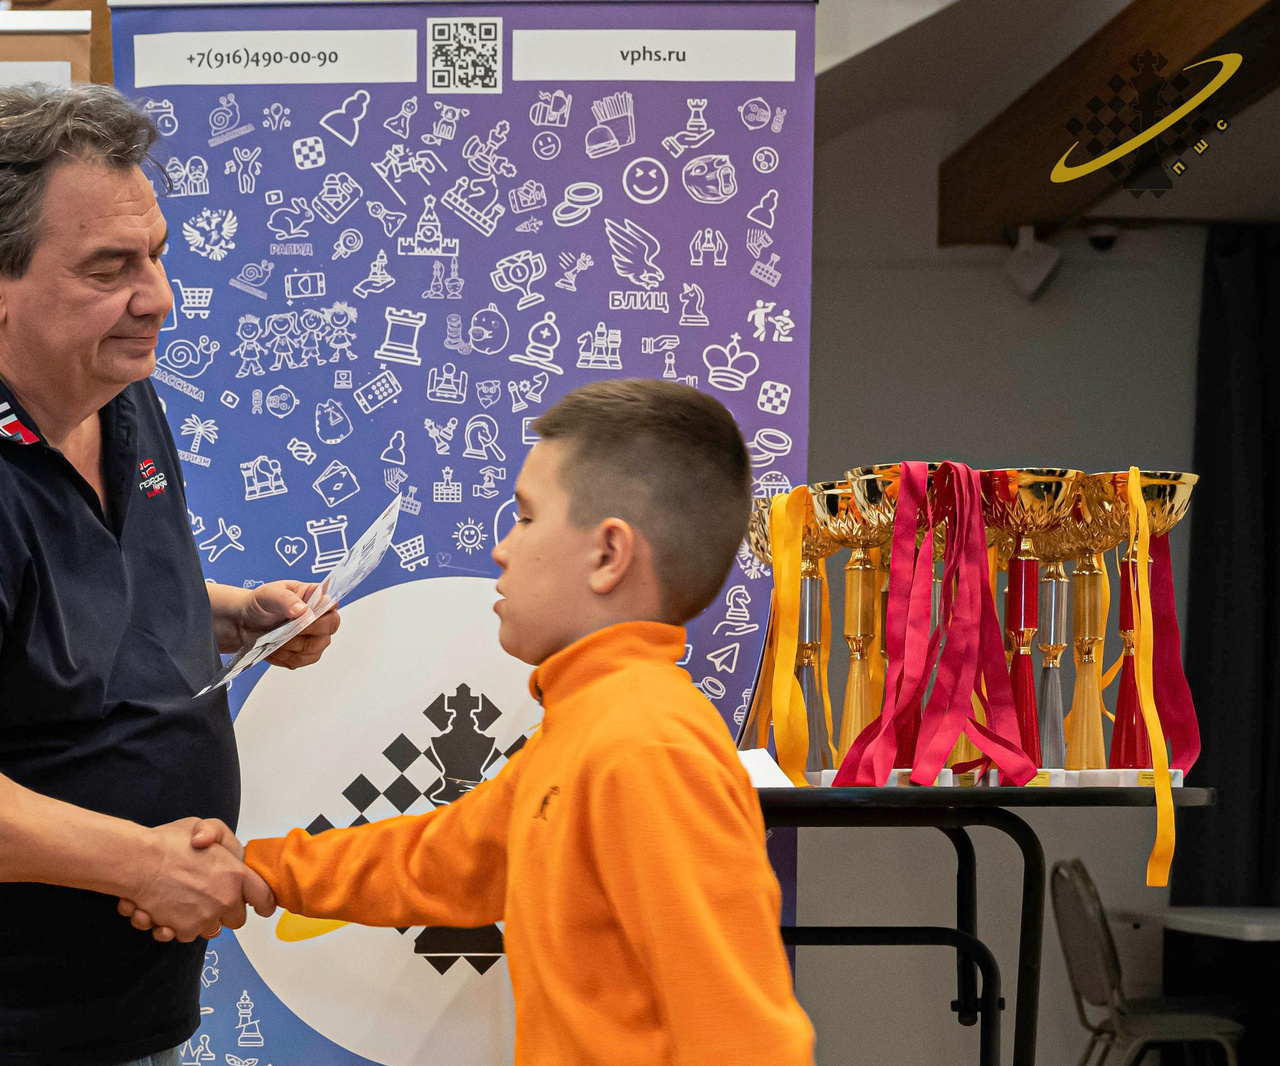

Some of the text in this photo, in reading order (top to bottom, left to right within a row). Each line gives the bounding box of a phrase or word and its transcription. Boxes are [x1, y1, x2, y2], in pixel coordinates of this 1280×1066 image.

[187, 48, 339, 69] +7(916)490-00-90
[620, 46, 687, 65] vphs.ru
[270, 243, 314, 256] РАПИД
[609, 291, 669, 313] БЛИЦ
[150, 367, 205, 402] ЛАССИКА
[177, 449, 211, 467] УРИЗМ
[284, 544, 298, 555] OK
